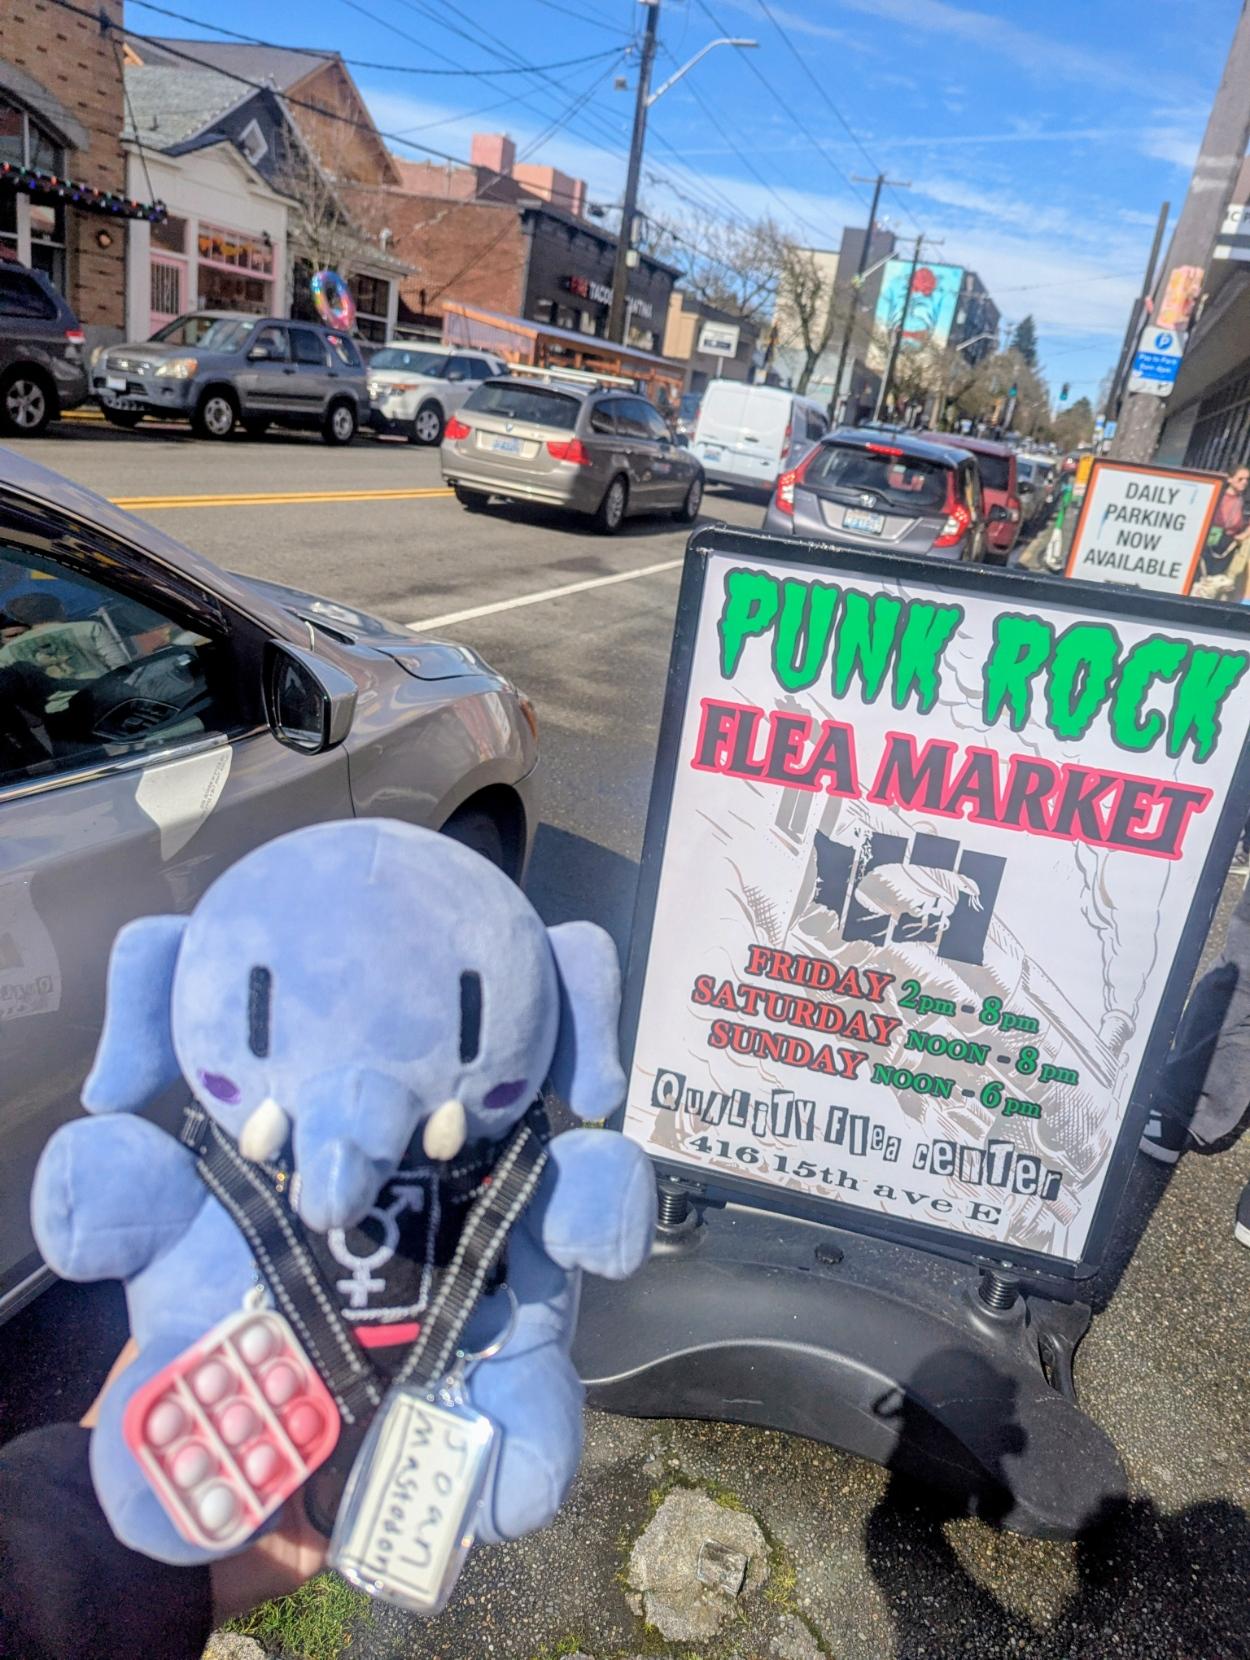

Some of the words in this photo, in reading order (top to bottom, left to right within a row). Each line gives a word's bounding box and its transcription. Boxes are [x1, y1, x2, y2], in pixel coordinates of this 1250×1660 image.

[1106, 504, 1187, 531] PARKING
[1125, 482, 1180, 505] DAILY
[1083, 548, 1183, 579] AVAILABLE
[1116, 530, 1162, 551] NOW
[717, 567, 965, 715] PUNK
[982, 612, 1250, 764] ROCK
[691, 698, 862, 799] FLEA
[867, 731, 1213, 860] MARKET
[744, 944, 896, 1003] FRIDAY
[898, 979, 957, 1017] 2pm
[961, 1005, 975, 1014] -
[691, 975, 902, 1047] SATURDAY
[904, 1029, 991, 1065] NOON
[997, 1055, 1011, 1064] -
[708, 1019, 868, 1080] SUNDAY
[871, 1063, 956, 1099] NOON
[962, 1089, 975, 1098] -
[689, 1135, 760, 1164] 416
[773, 1154, 860, 1191] 15th
[873, 1183, 953, 1213] ave
[964, 1200, 1002, 1225] E
